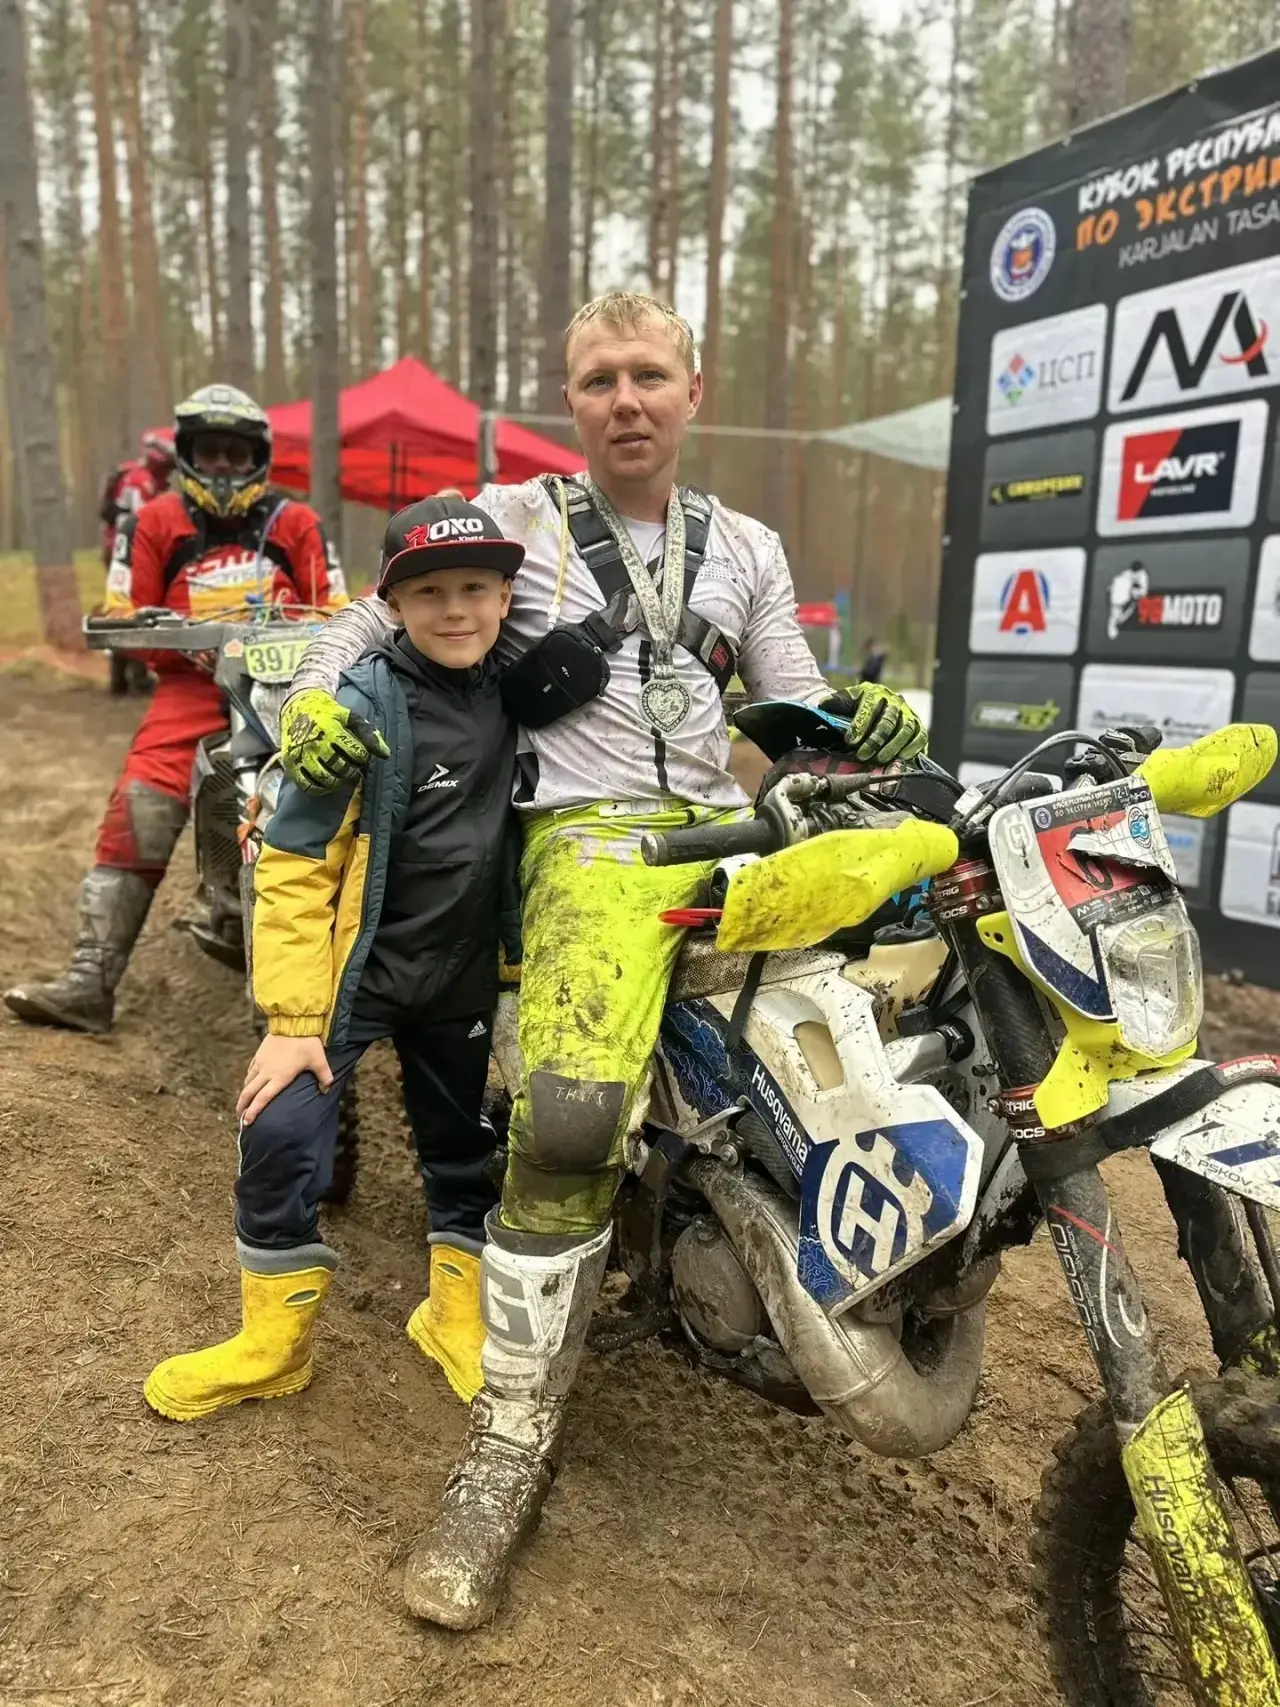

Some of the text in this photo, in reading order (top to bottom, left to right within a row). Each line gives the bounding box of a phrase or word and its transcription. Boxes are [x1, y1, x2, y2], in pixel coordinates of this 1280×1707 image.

[1078, 157, 1161, 214] КУБОК
[1076, 209, 1120, 251] ПО
[1118, 217, 1219, 268] KARJALAN
[1038, 349, 1097, 390] ЦСП
[417, 780, 459, 793] DEMIX
[751, 1063, 809, 1163] Husqvarna
[775, 1126, 804, 1176] MOTORCYCLES
[1198, 1160, 1253, 1187] PSKOV
